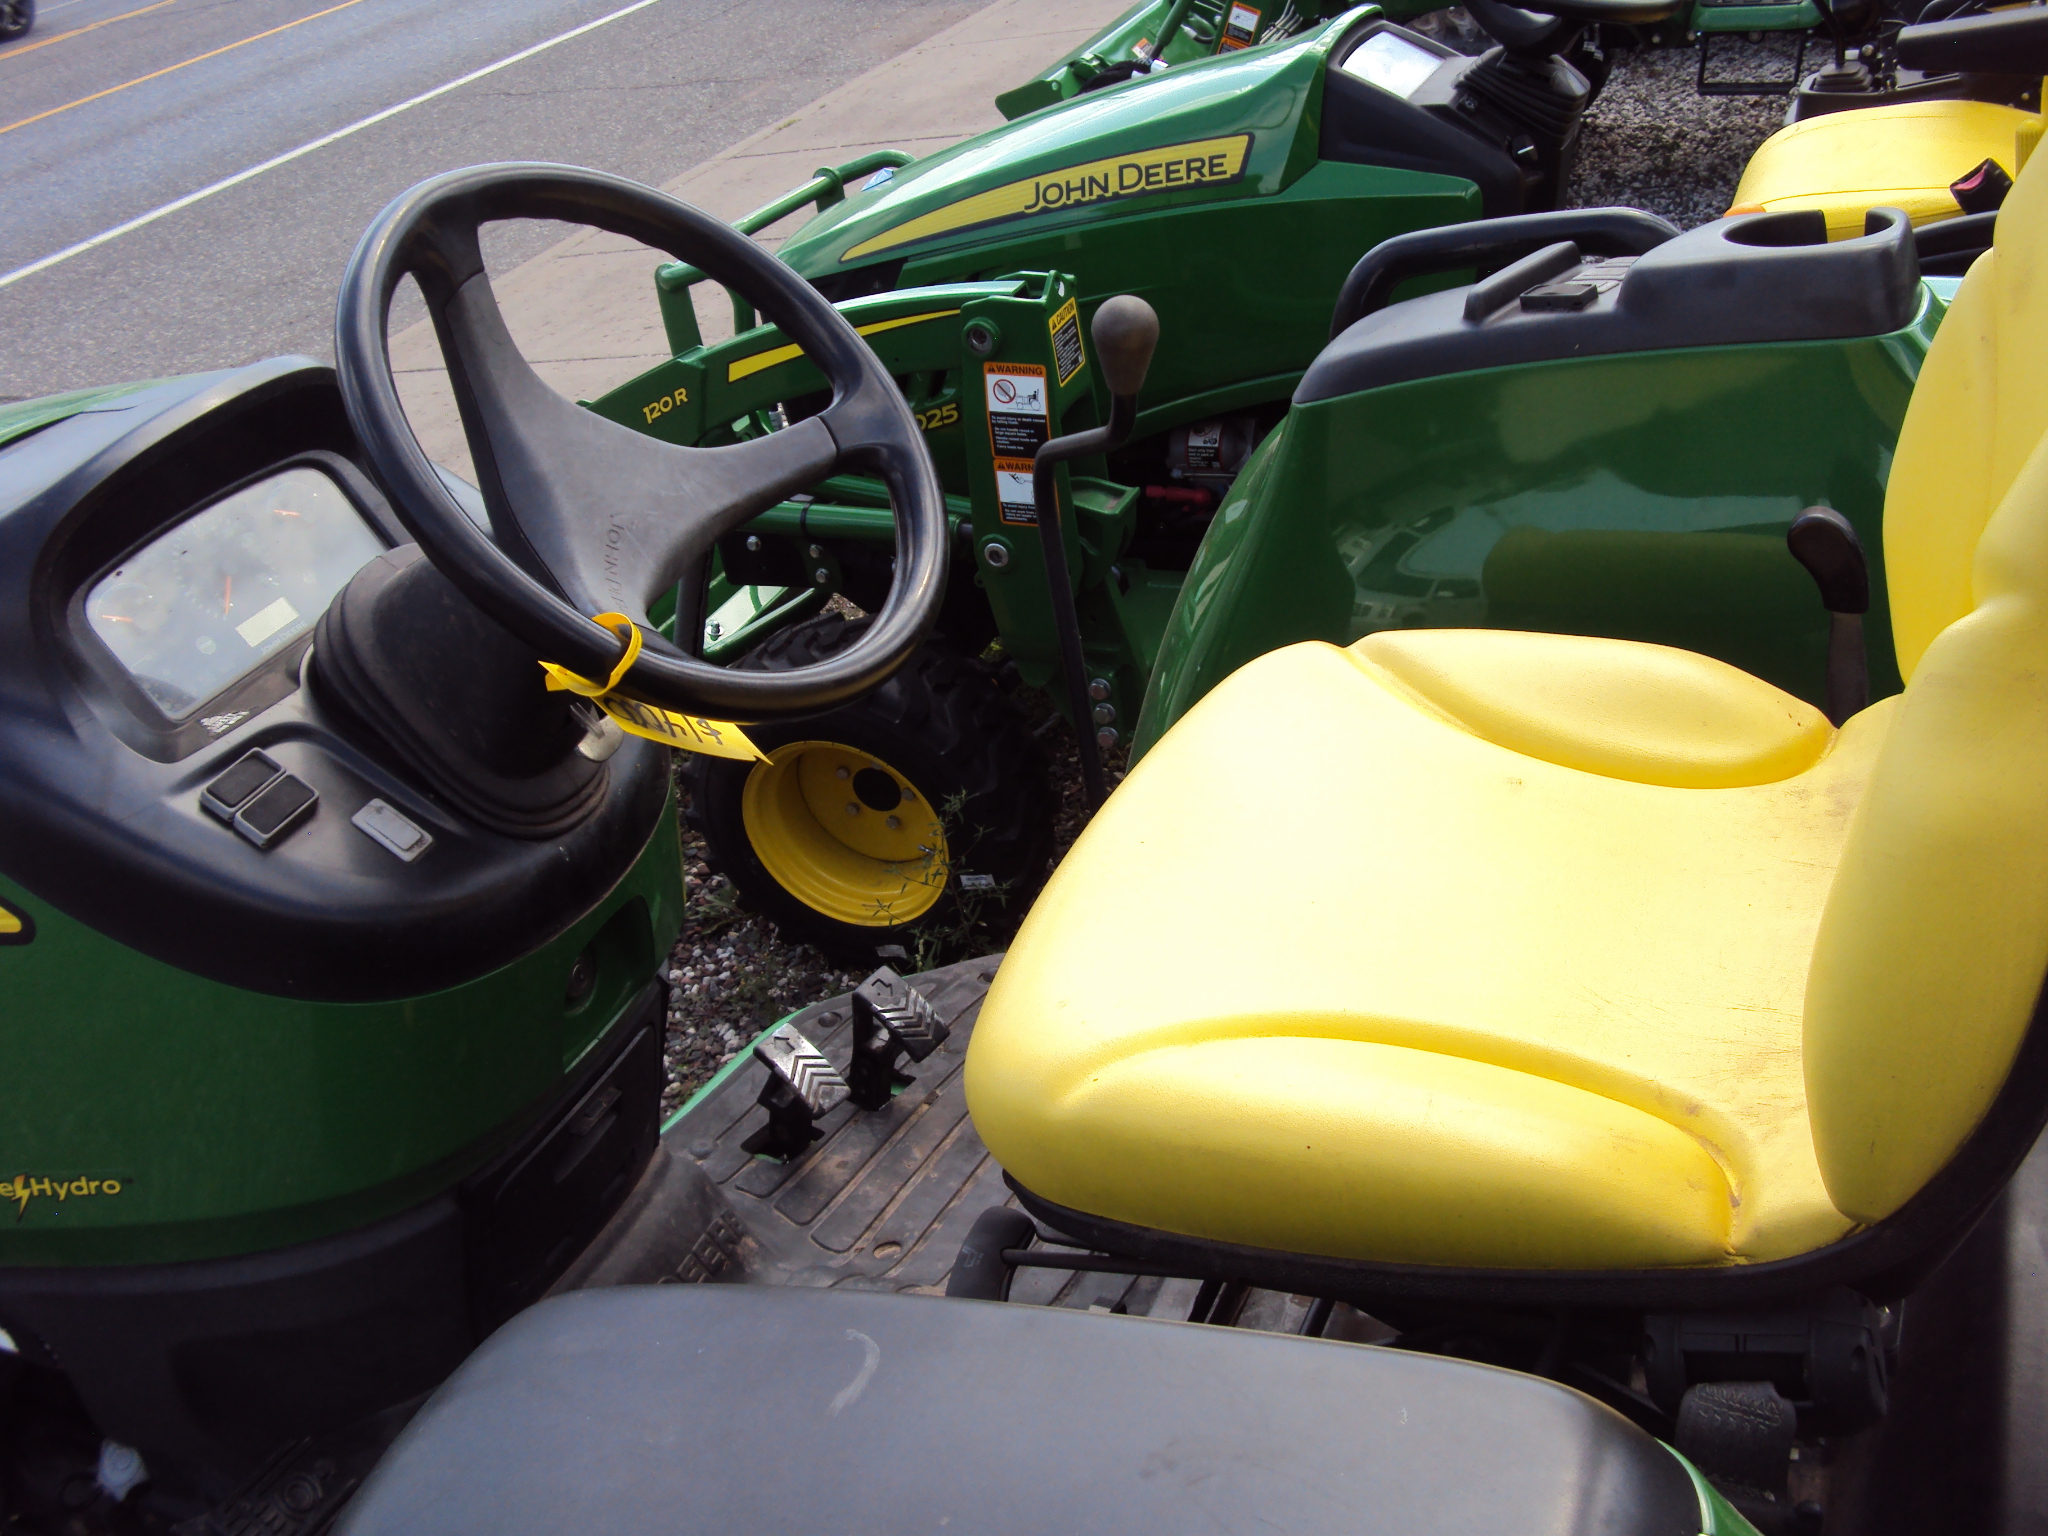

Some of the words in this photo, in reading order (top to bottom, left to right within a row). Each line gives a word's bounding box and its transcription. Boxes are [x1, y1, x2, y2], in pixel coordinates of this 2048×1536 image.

[1023, 173, 1111, 212] JOHN
[1118, 153, 1228, 192] DEERE
[996, 364, 1043, 376] WARNING
[1005, 461, 1035, 472] WARN
